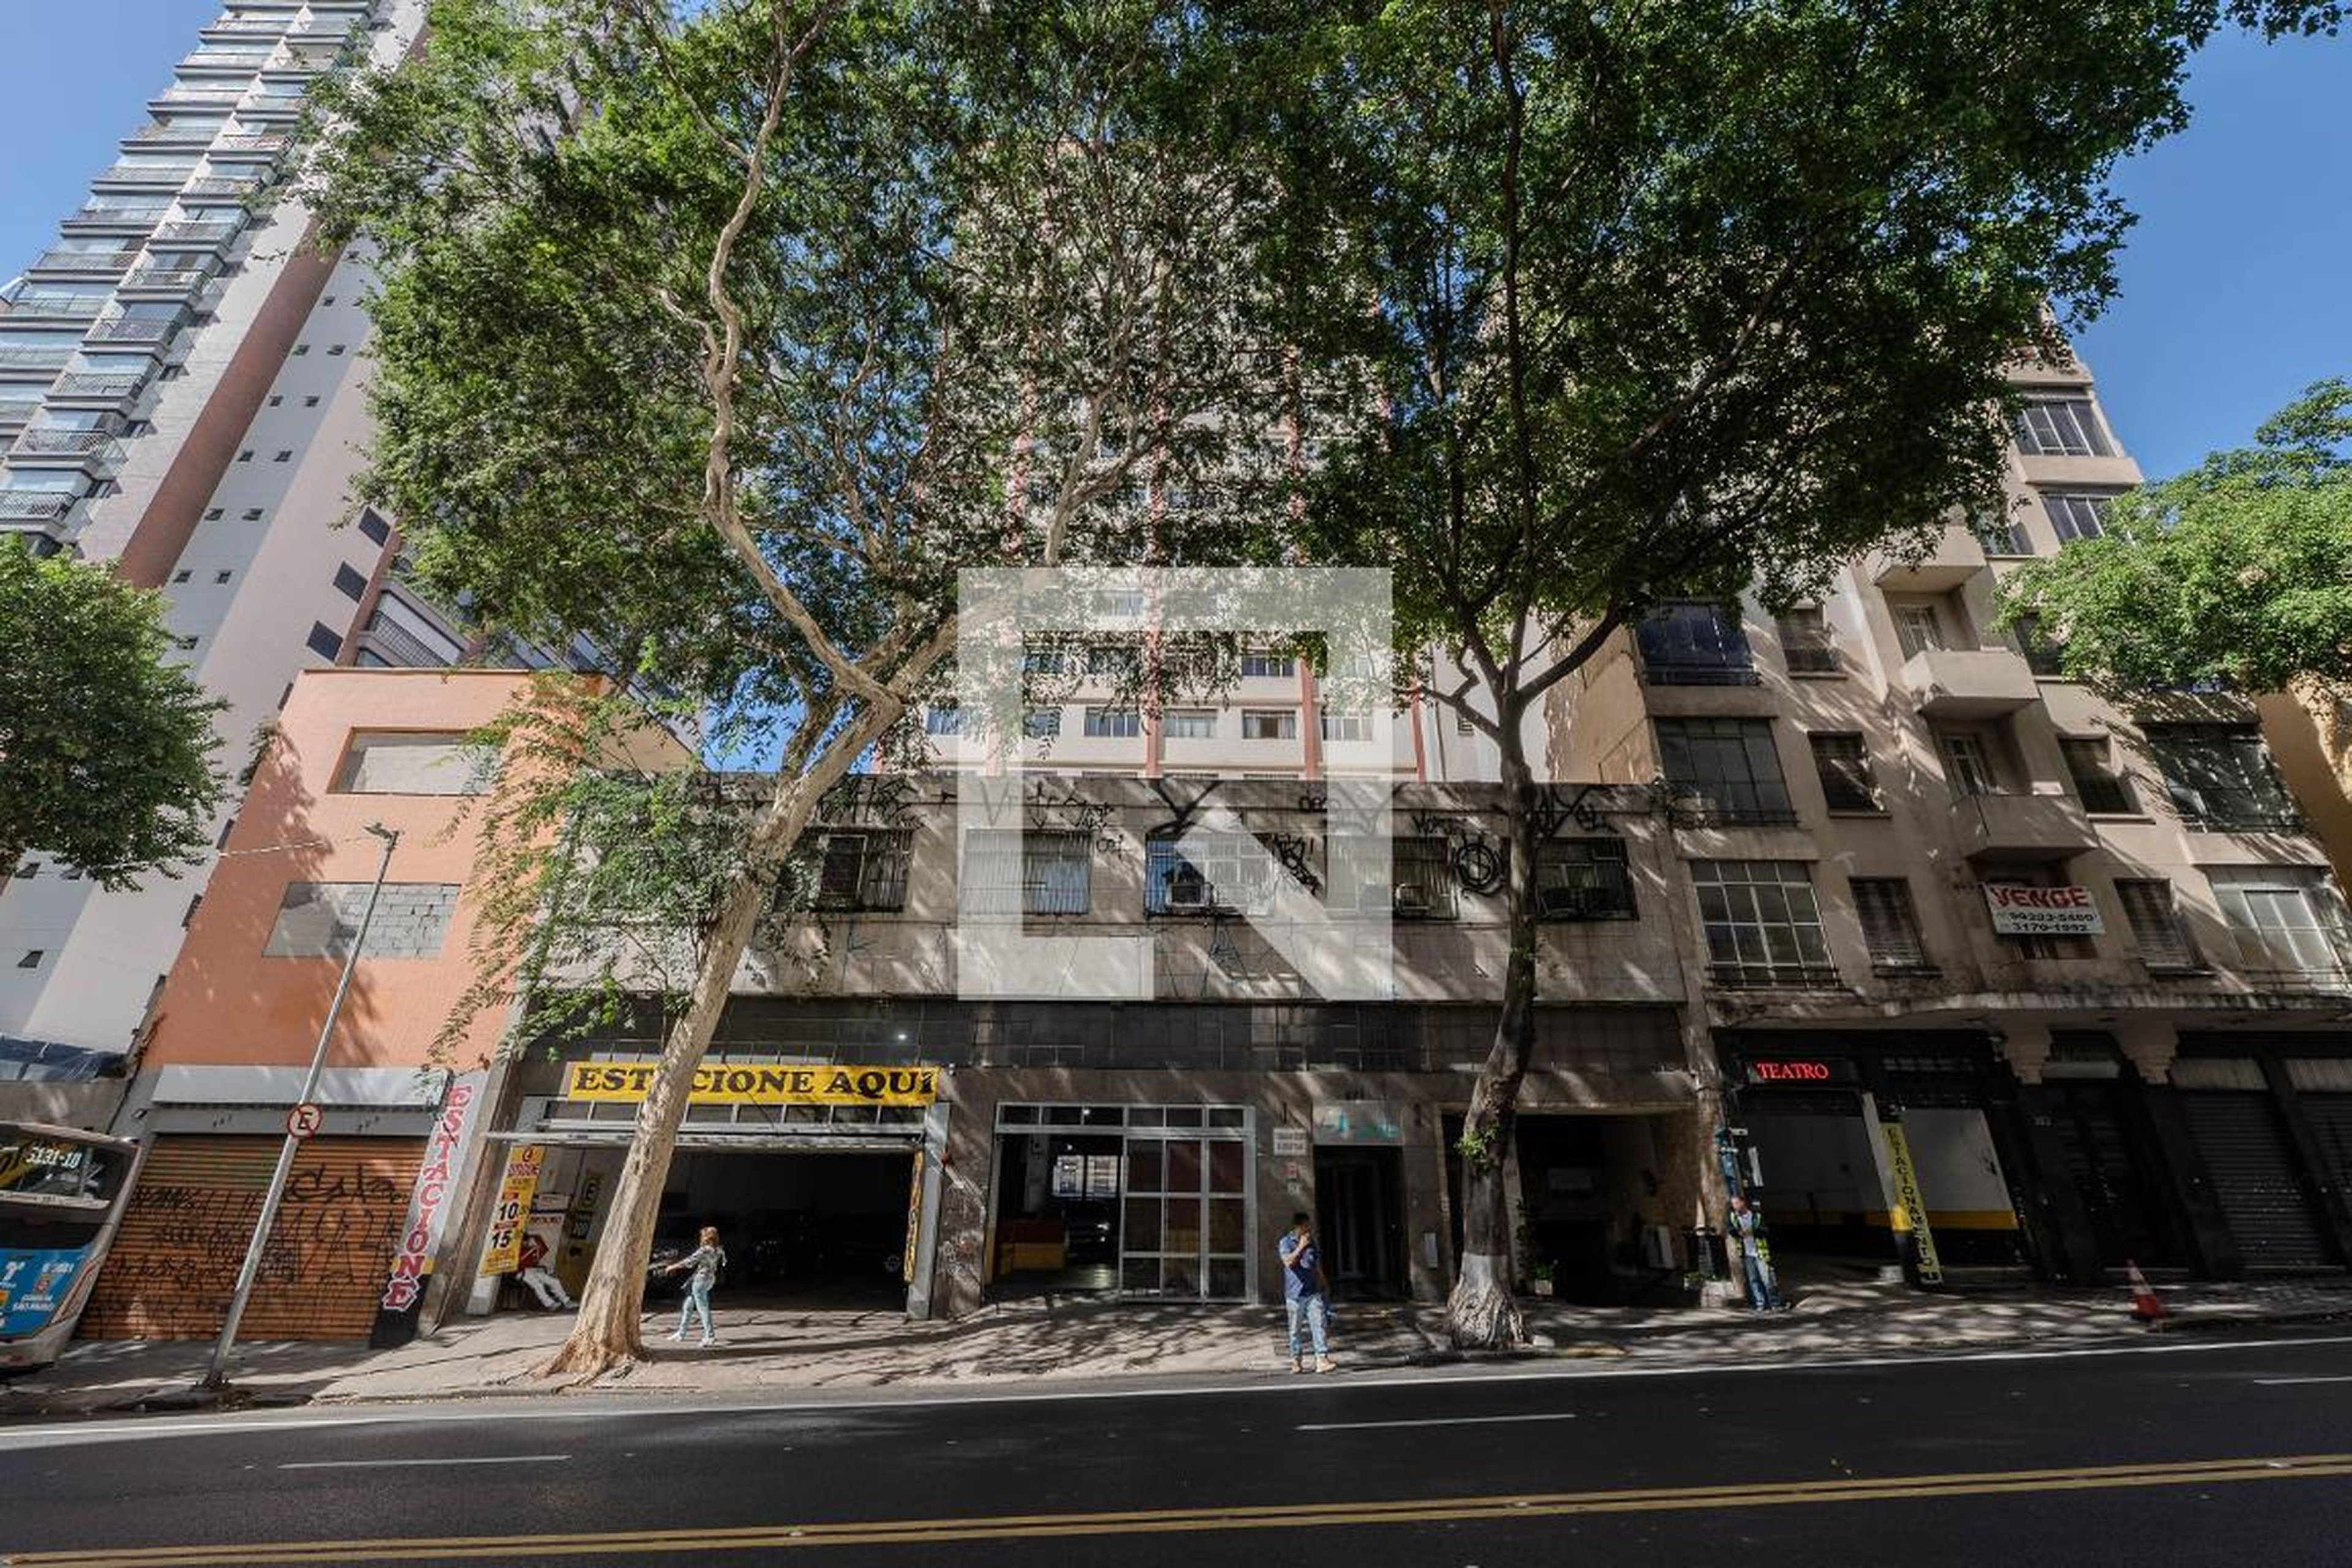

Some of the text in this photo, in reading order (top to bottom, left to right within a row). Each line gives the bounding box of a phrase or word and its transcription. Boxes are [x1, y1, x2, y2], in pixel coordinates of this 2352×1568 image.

[1757, 1063, 1829, 1079] TEATRO
[575, 1068, 815, 1093] ESTCIONE
[297, 1111, 313, 1129] E
[384, 1085, 472, 1310] ESTACIONE
[499, 1202, 518, 1221] 10
[492, 1231, 512, 1249] 15
